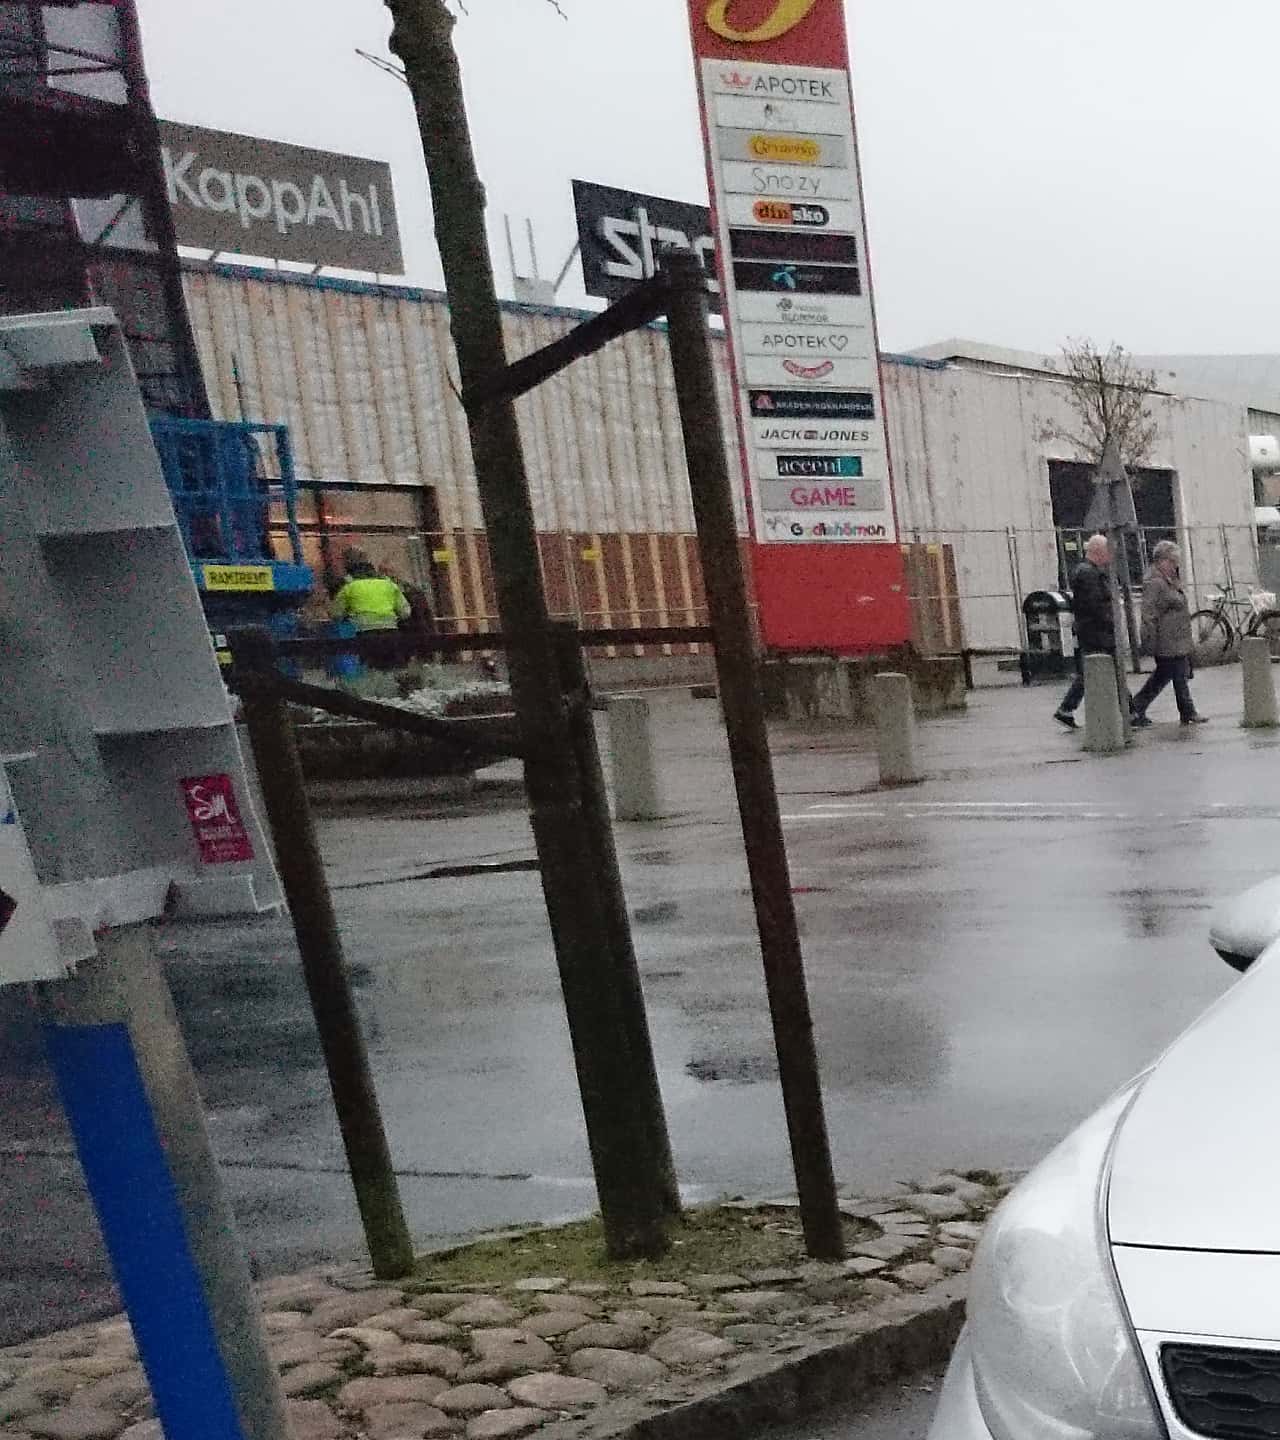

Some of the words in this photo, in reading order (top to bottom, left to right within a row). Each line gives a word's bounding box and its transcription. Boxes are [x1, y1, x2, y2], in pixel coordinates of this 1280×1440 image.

[754, 76, 833, 97] APOTEK
[161, 148, 383, 236] KappAhl
[762, 334, 826, 349] APOTEK
[760, 428, 802, 440] JACK
[819, 430, 870, 441] JONES
[790, 486, 857, 508] GAME
